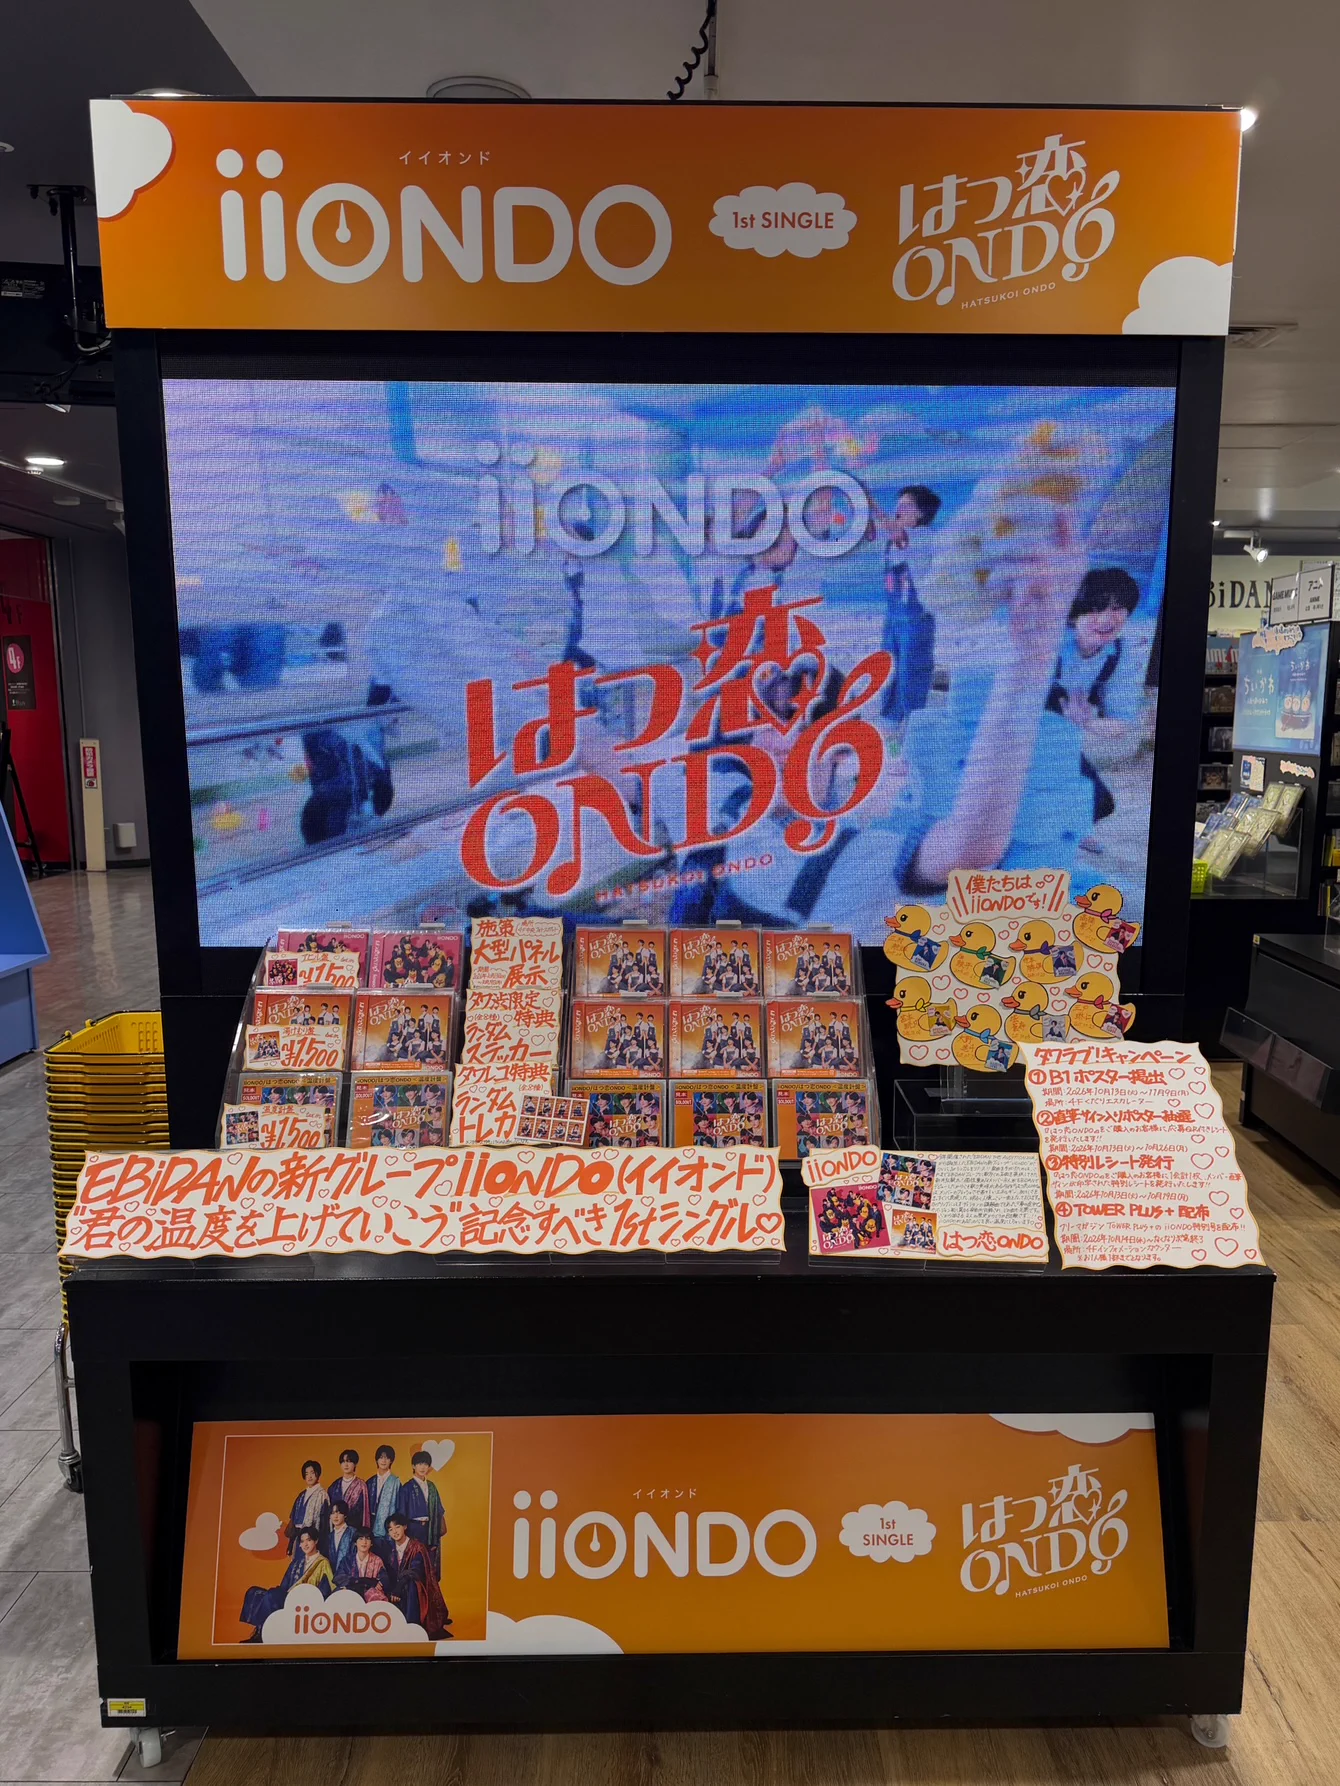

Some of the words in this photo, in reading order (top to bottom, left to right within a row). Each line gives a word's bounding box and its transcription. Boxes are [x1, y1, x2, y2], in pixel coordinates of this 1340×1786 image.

[398, 150, 492, 165] イイオンド
[898, 133, 1087, 245] はつ恋
[216, 149, 672, 285] iiONDO
[731, 211, 756, 229] 1st
[760, 211, 834, 230] SINGLE
[891, 170, 1121, 306] ONDO
[960, 290, 1019, 310] HATSUKOI
[1022, 281, 1057, 299] ONDO
[474, 440, 870, 557] iiONDO
[464, 584, 828, 789] はつ恋
[460, 650, 893, 896] ONDO
[594, 873, 706, 901] HATSUKOI
[712, 853, 774, 880] ONDO
[965, 874, 1032, 894] 僕たちは
[475, 919, 515, 938] 施策
[473, 939, 560, 964] 大型パネル
[502, 964, 549, 989] 展示
[468, 991, 541, 1010] タワ渋限定
[514, 1009, 557, 1028] 特典
[466, 1022, 512, 1044] ランダム
[466, 1038, 552, 1064] ステッカー
[457, 1063, 551, 1087] タワレコ特典
[261, 1105, 297, 1115] 温度計盤
[455, 1086, 517, 1116] ランダム
[458, 1111, 518, 1144] トレカ
[807, 1150, 878, 1183] iiONDO
[1045, 1154, 1175, 1171] ③特別レシート発行
[1178, 1204, 1212, 1221] 配布
[942, 1230, 1044, 1253] はつ恋ONDO
[633, 1488, 698, 1499] イイオンド
[962, 1464, 1103, 1549] はつ恋
[513, 1489, 817, 1581] iiONDO
[879, 1516, 896, 1531] 1st
[862, 1531, 915, 1547] SINGLE
[960, 1489, 1129, 1596] ONDO
[1015, 1581, 1060, 1598] HATSUKOI
[1061, 1574, 1088, 1586] ONDO
[294, 1606, 393, 1635] iiONDO
